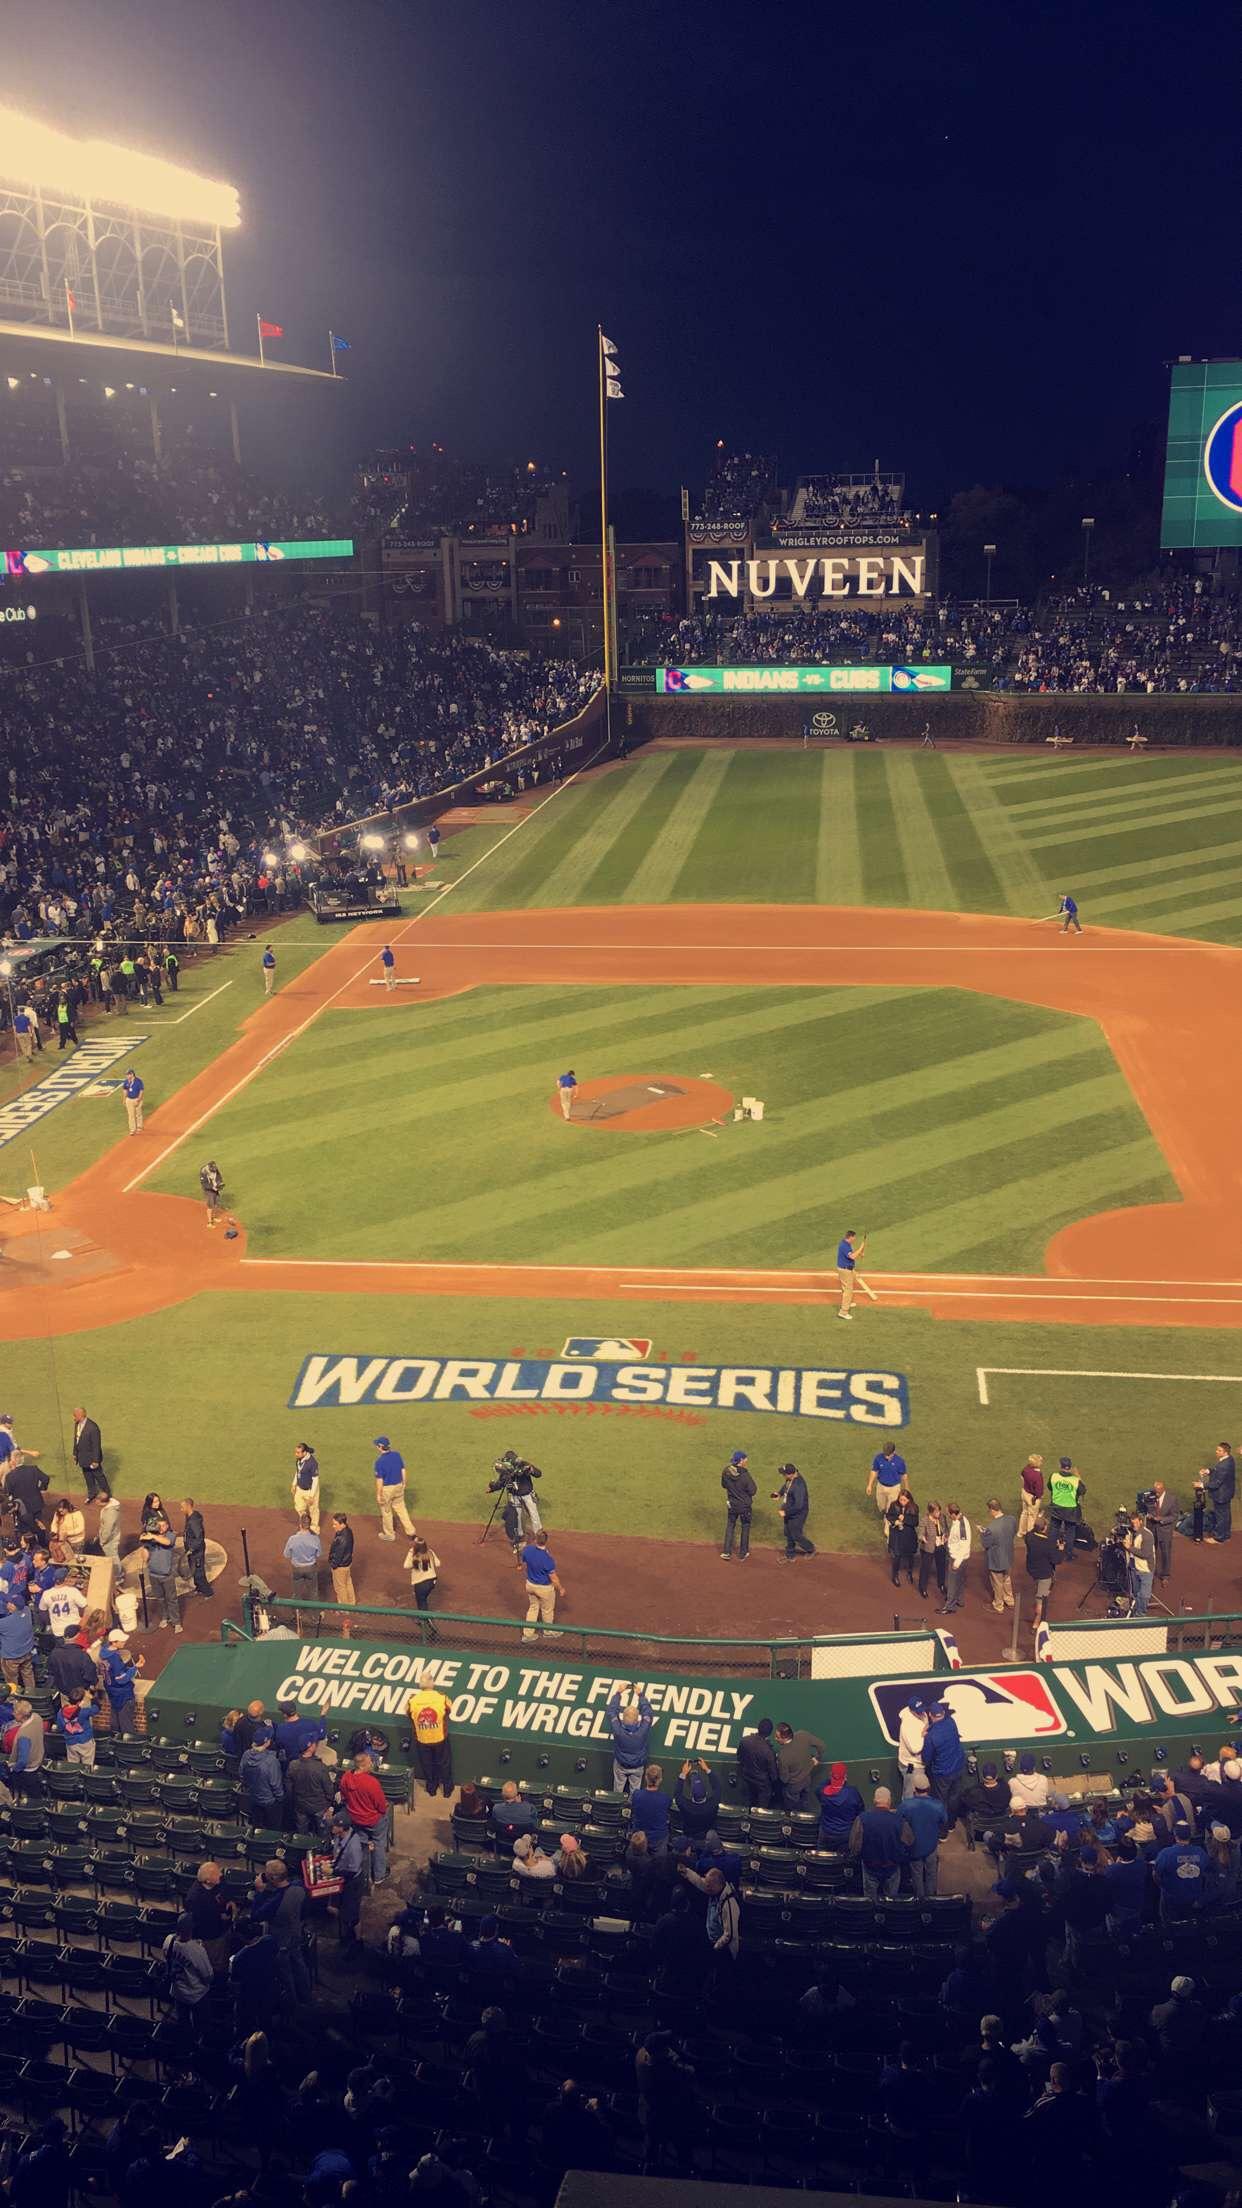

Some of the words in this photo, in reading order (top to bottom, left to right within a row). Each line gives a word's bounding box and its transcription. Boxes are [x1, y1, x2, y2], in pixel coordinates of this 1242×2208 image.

[690, 522, 745, 530] 773-248-ROOF
[779, 535, 899, 547] WRIGLEYROOFTOPS.COM
[707, 556, 925, 598] NUVEEN
[622, 674, 655, 683] HORNITOS
[723, 670, 798, 689] INDIANS
[830, 669, 880, 689] CUBS
[809, 728, 840, 736] TOYOTA
[295, 1357, 599, 1406] WORLD
[611, 1365, 904, 1427] SERIES
[52, 1602, 70, 1617] 44
[295, 1645, 462, 1688] WELCOME
[465, 1662, 510, 1693] TO
[519, 1667, 588, 1701] THE
[586, 1676, 754, 1720] FRIENDLY
[450, 1693, 498, 1725] OF
[664, 1718, 758, 1754] FIEL
